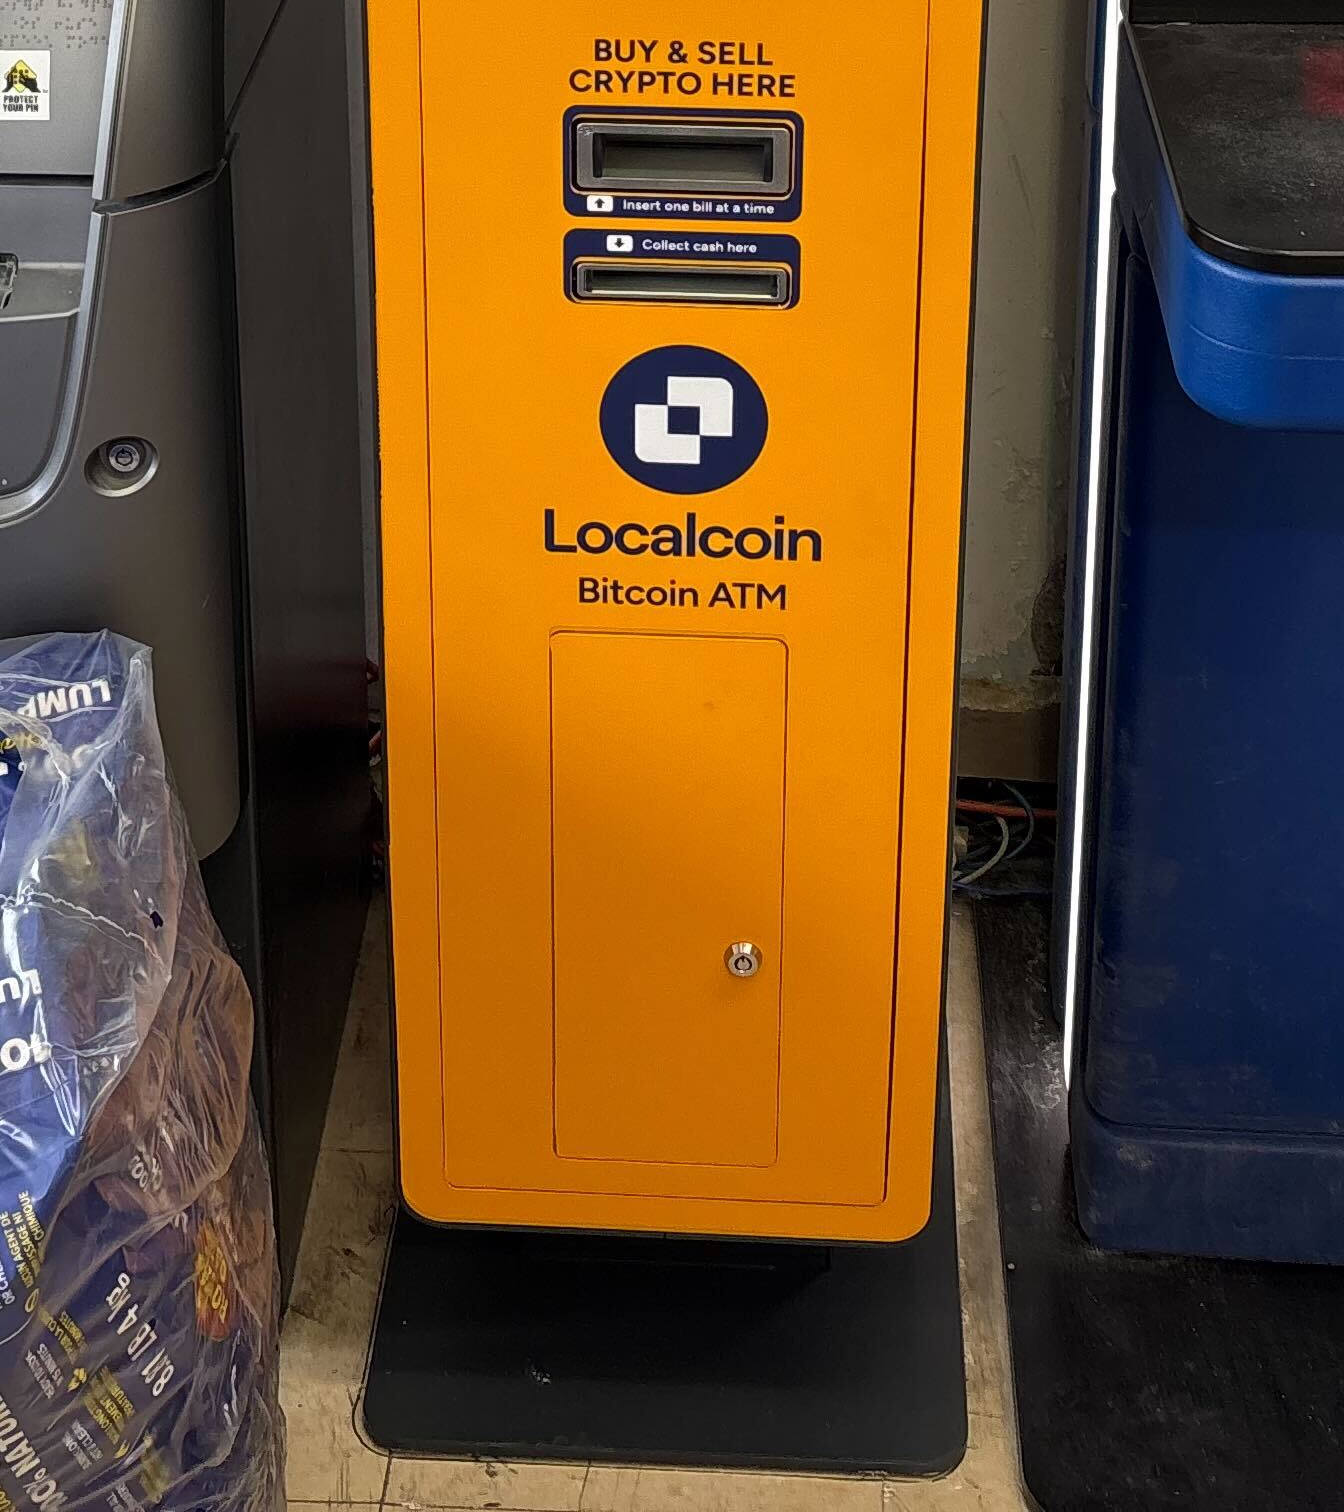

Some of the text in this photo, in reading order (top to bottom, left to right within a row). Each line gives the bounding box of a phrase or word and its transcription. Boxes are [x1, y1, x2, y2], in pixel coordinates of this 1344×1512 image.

[594, 38, 773, 66] BUY & SELL
[569, 69, 796, 97] CRYPTO HERE
[3, 104, 38, 112] YOUR PIN
[4, 95, 38, 103] PROTECT
[623, 199, 774, 214] Insert one bill at a time
[642, 239, 757, 253] Collect cash here
[544, 508, 822, 562] Localcoin
[578, 577, 787, 610] Bitcoin ATM
